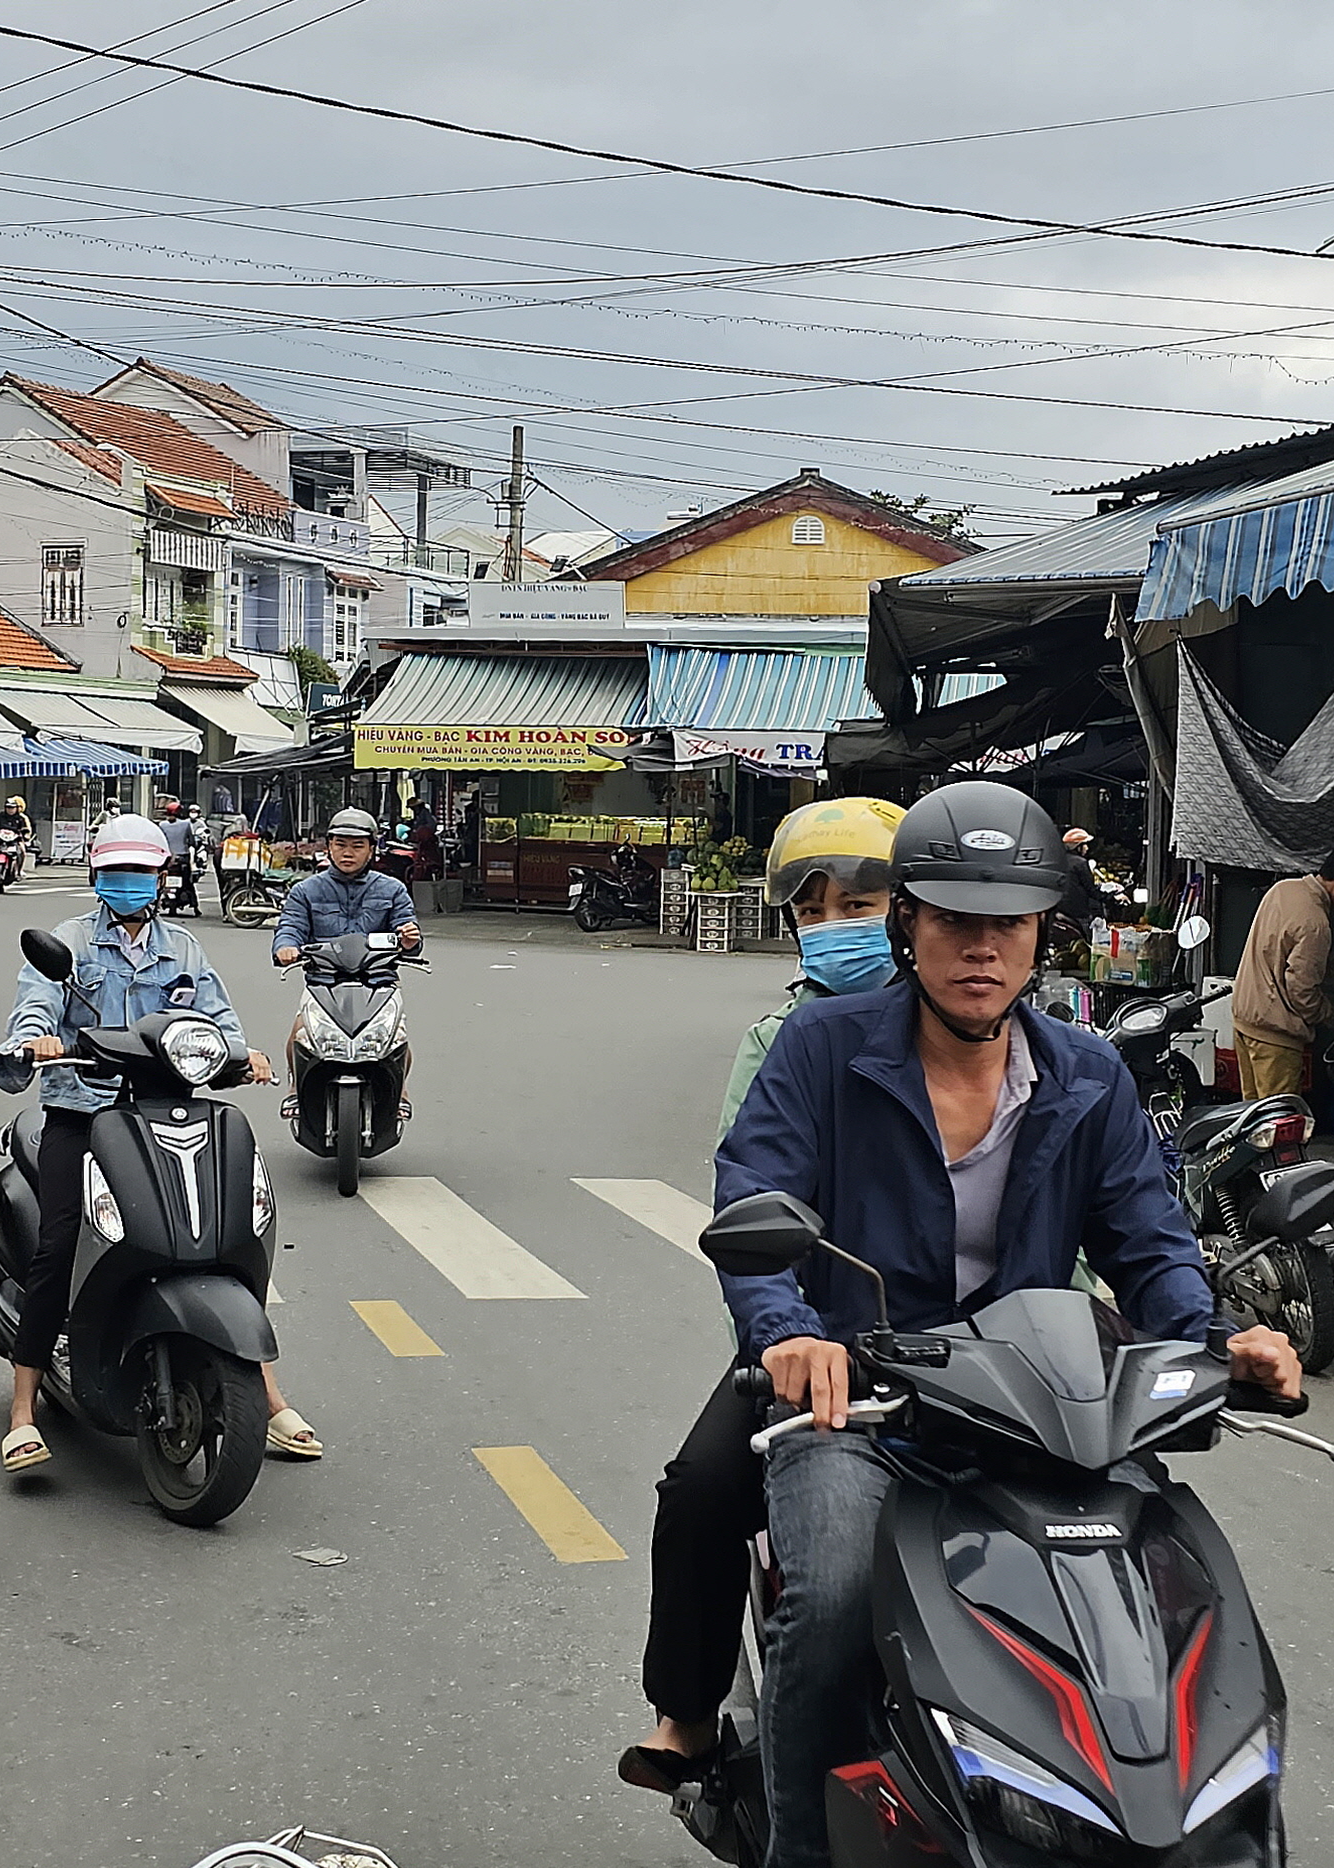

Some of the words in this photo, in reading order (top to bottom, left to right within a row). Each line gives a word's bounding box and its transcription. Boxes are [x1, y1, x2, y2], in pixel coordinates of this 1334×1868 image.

[357, 728, 384, 743] HIỆU
[388, 727, 424, 741] VÀNG
[434, 730, 460, 746] BẠC
[466, 729, 510, 744] KIM
[519, 724, 587, 744] HOÀN
[417, 746, 438, 755] MUA
[442, 744, 462, 755] BÁN
[470, 746, 489, 756] GIA
[1045, 1523, 1123, 1538] HONDA
